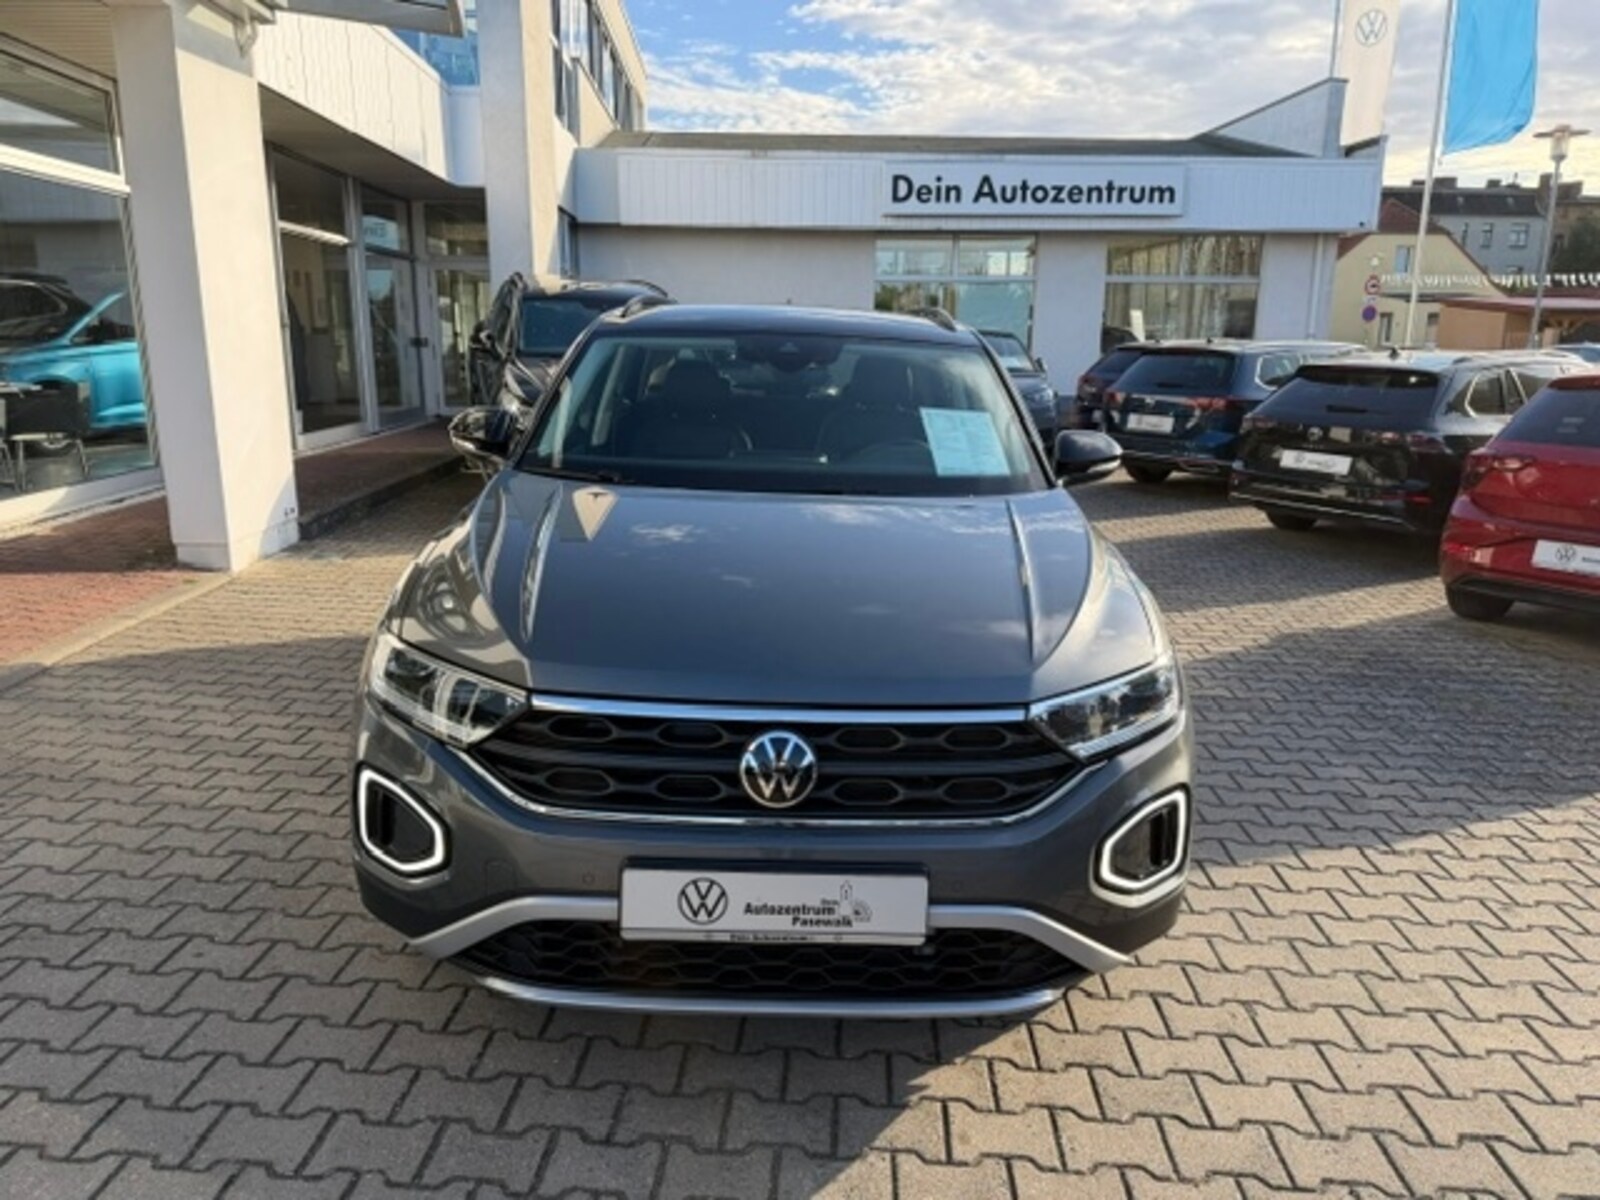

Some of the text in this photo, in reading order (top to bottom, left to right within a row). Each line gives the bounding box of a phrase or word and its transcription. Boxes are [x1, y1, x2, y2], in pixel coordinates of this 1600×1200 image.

[891, 174, 1177, 205] Dein Autozentrum
[741, 732, 816, 806] VW
[679, 878, 728, 923] VW
[743, 902, 836, 916] Autozentrum
[791, 915, 854, 928] Pasewalk
